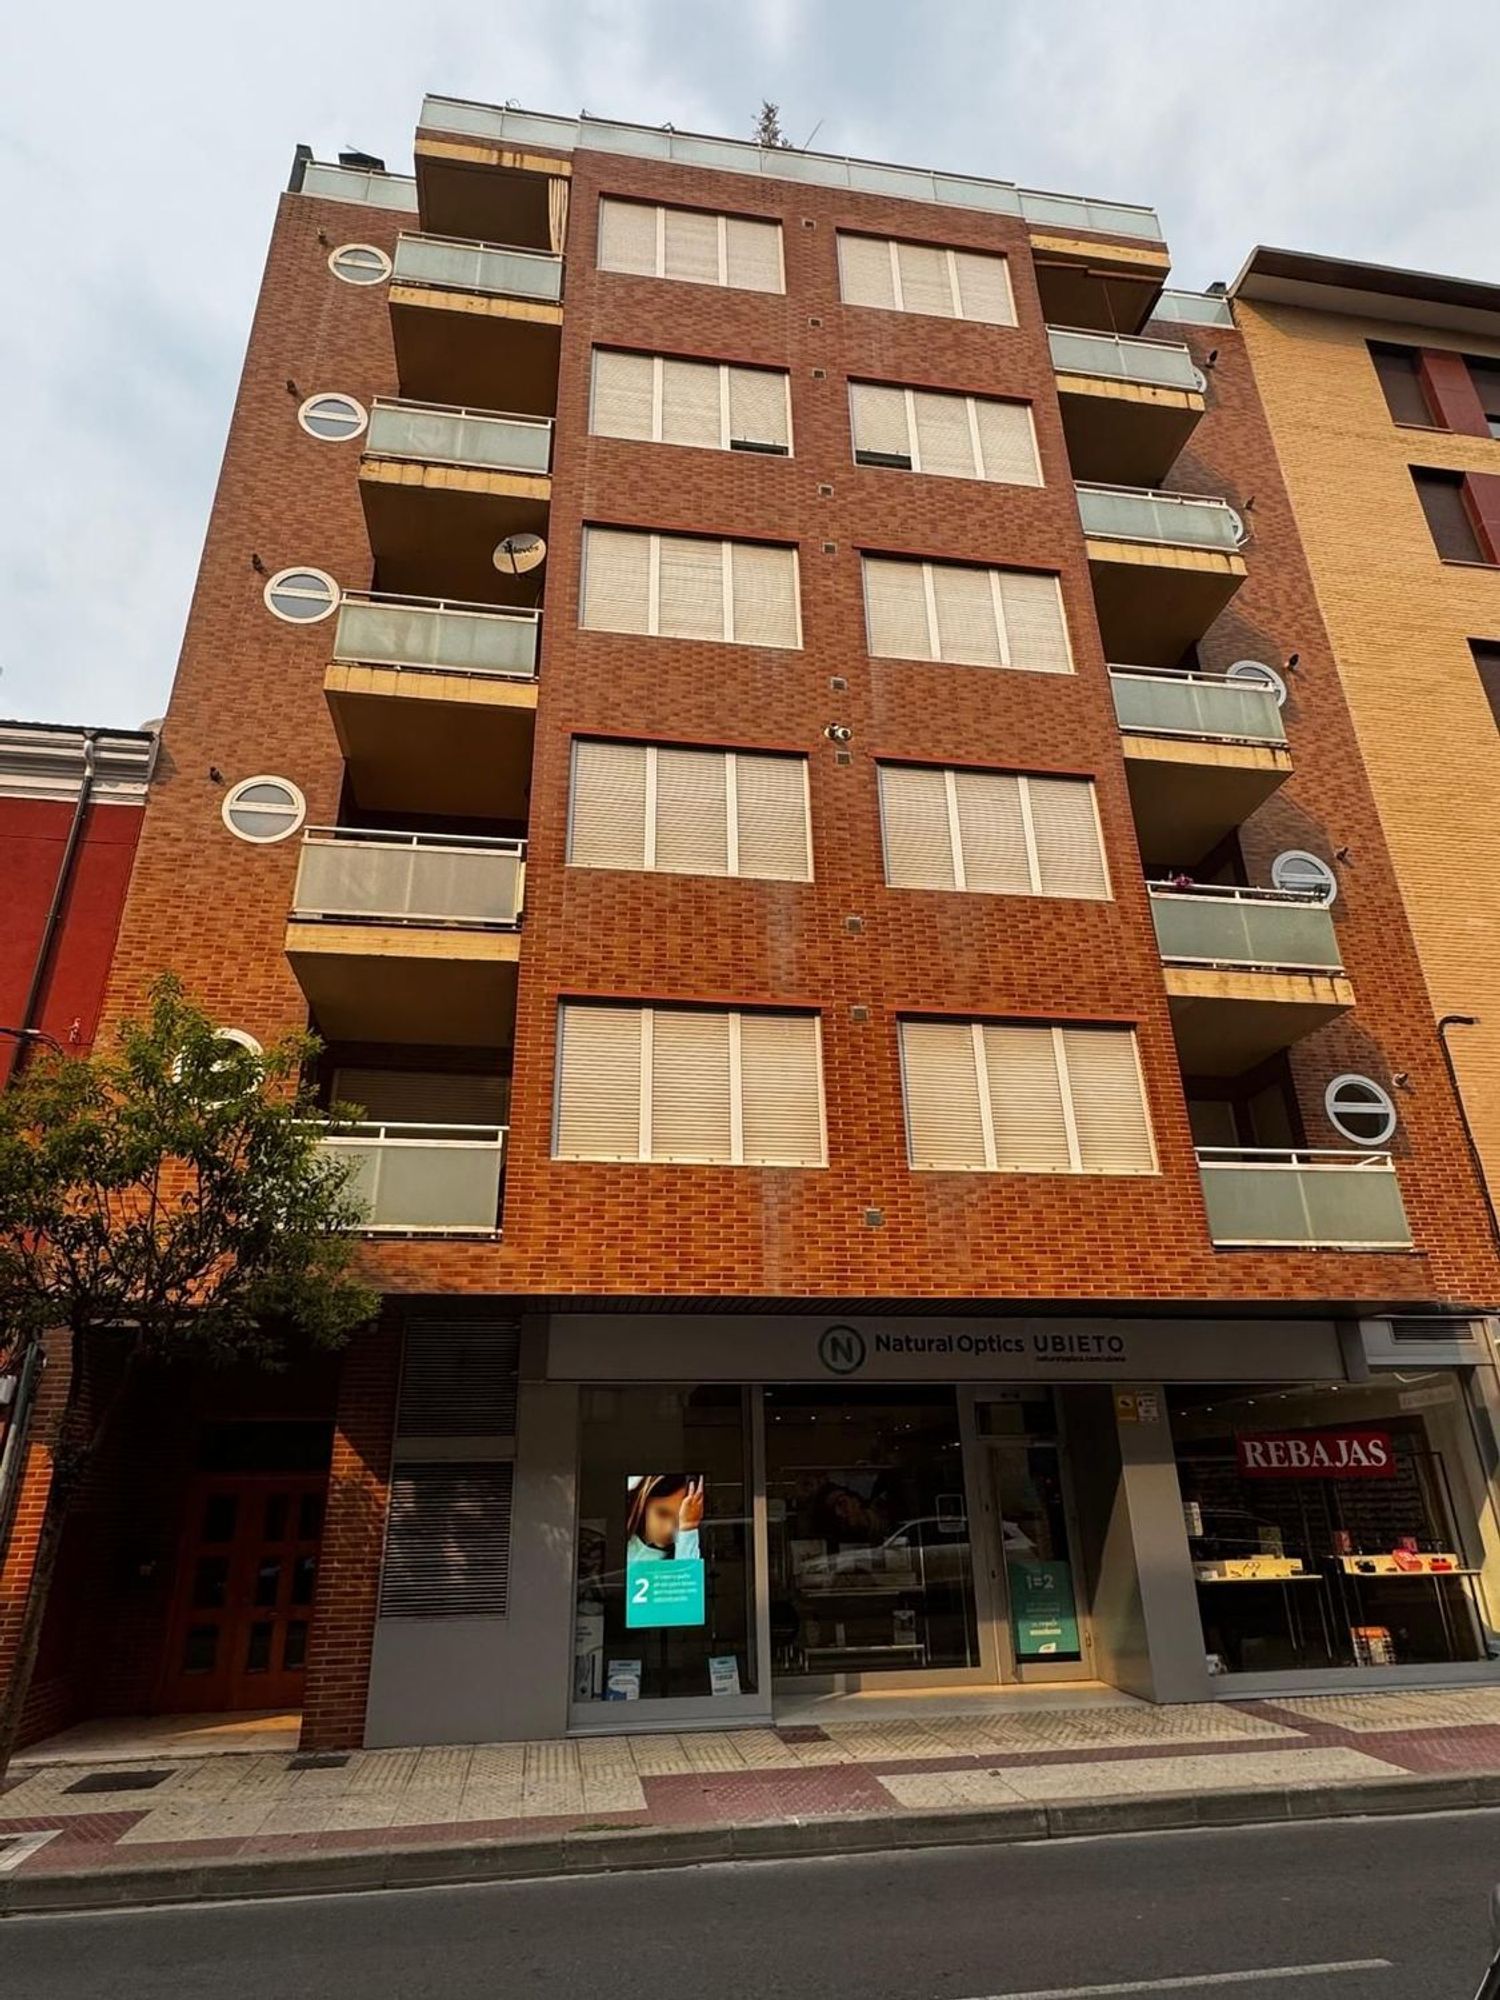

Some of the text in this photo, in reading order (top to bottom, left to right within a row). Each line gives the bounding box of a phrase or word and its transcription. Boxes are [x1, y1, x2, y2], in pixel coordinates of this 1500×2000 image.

[875, 1334, 1124, 1356] Natural Optics UBIETO
[1241, 1438, 1388, 1469] REBAJAS
[631, 1578, 650, 1603] 2
